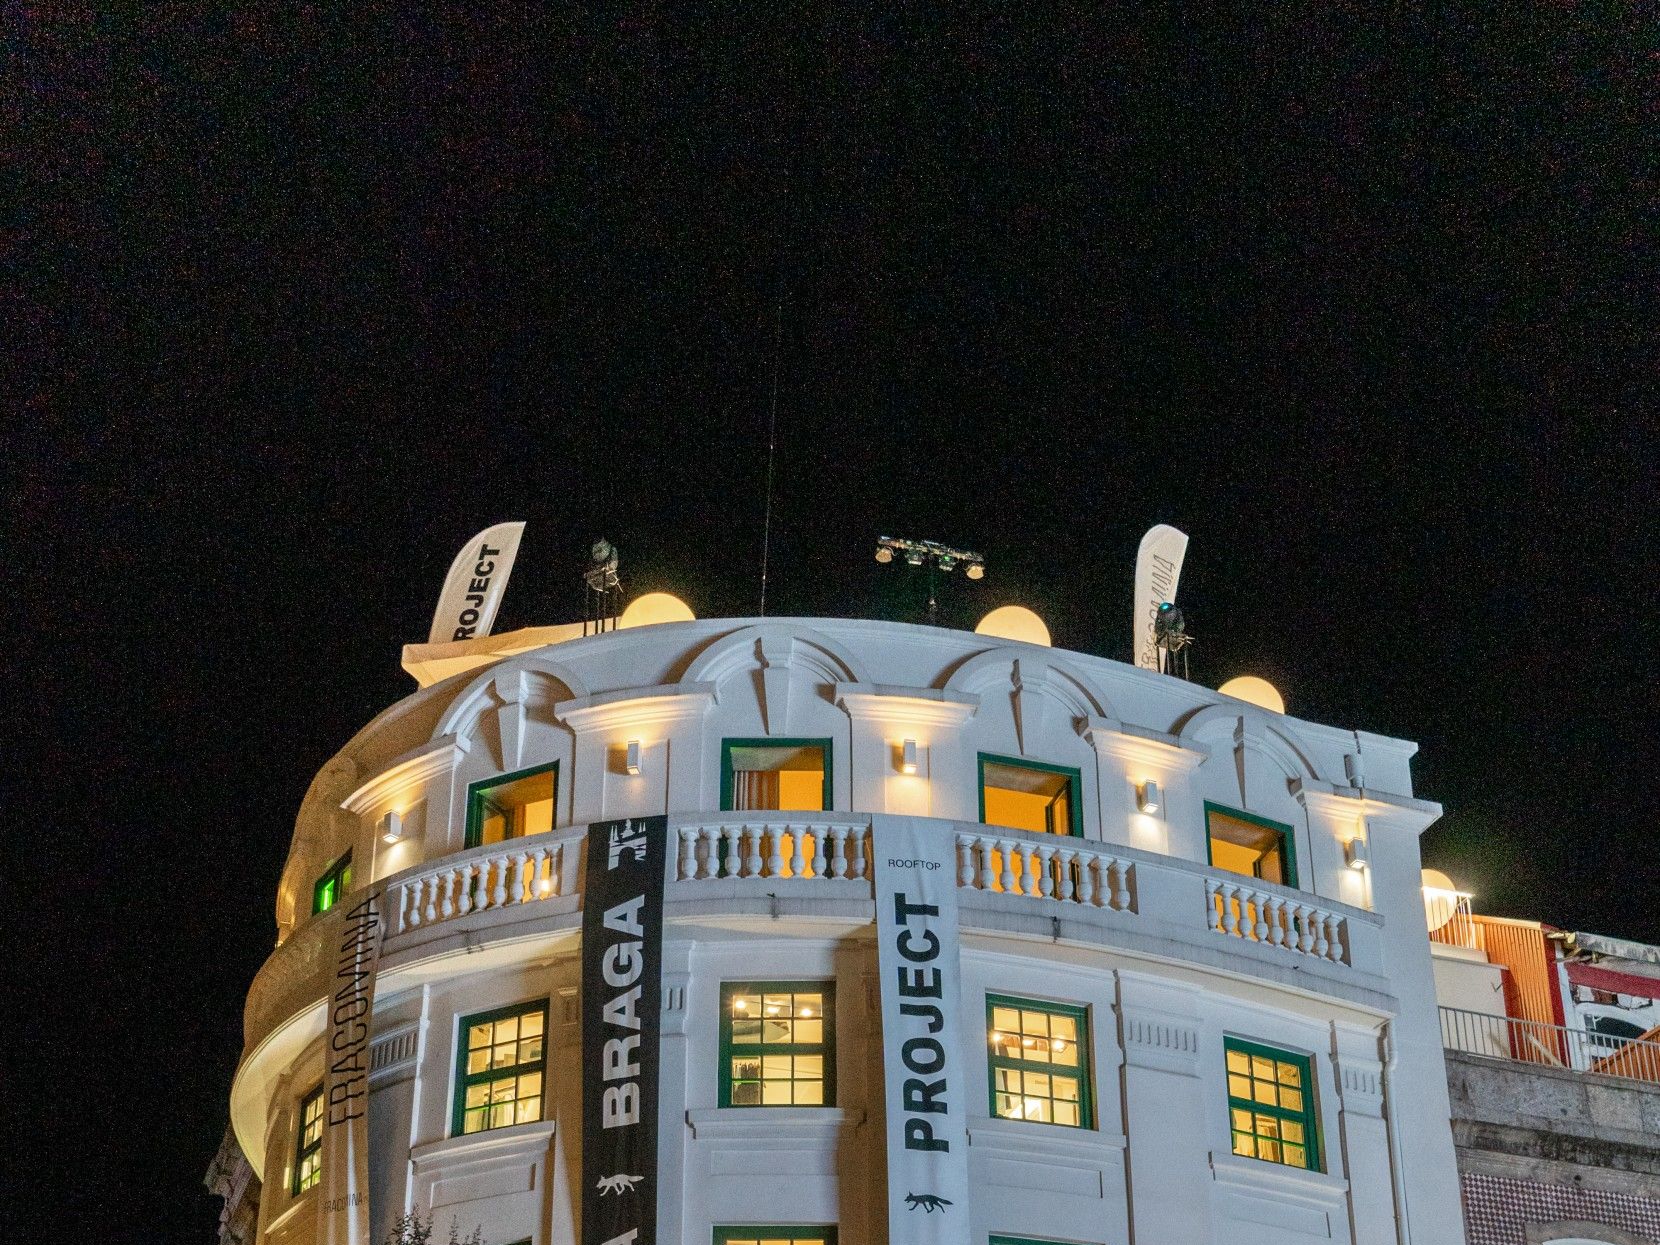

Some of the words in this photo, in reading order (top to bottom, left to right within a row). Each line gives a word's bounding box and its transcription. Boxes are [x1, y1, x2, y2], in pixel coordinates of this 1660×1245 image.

[451, 543, 501, 641] ROJECT
[888, 858, 941, 871] ROOFTOP
[328, 892, 381, 1127] FRACOMINA
[602, 893, 645, 1129] BRAGA
[894, 892, 950, 1152] PROJECT
